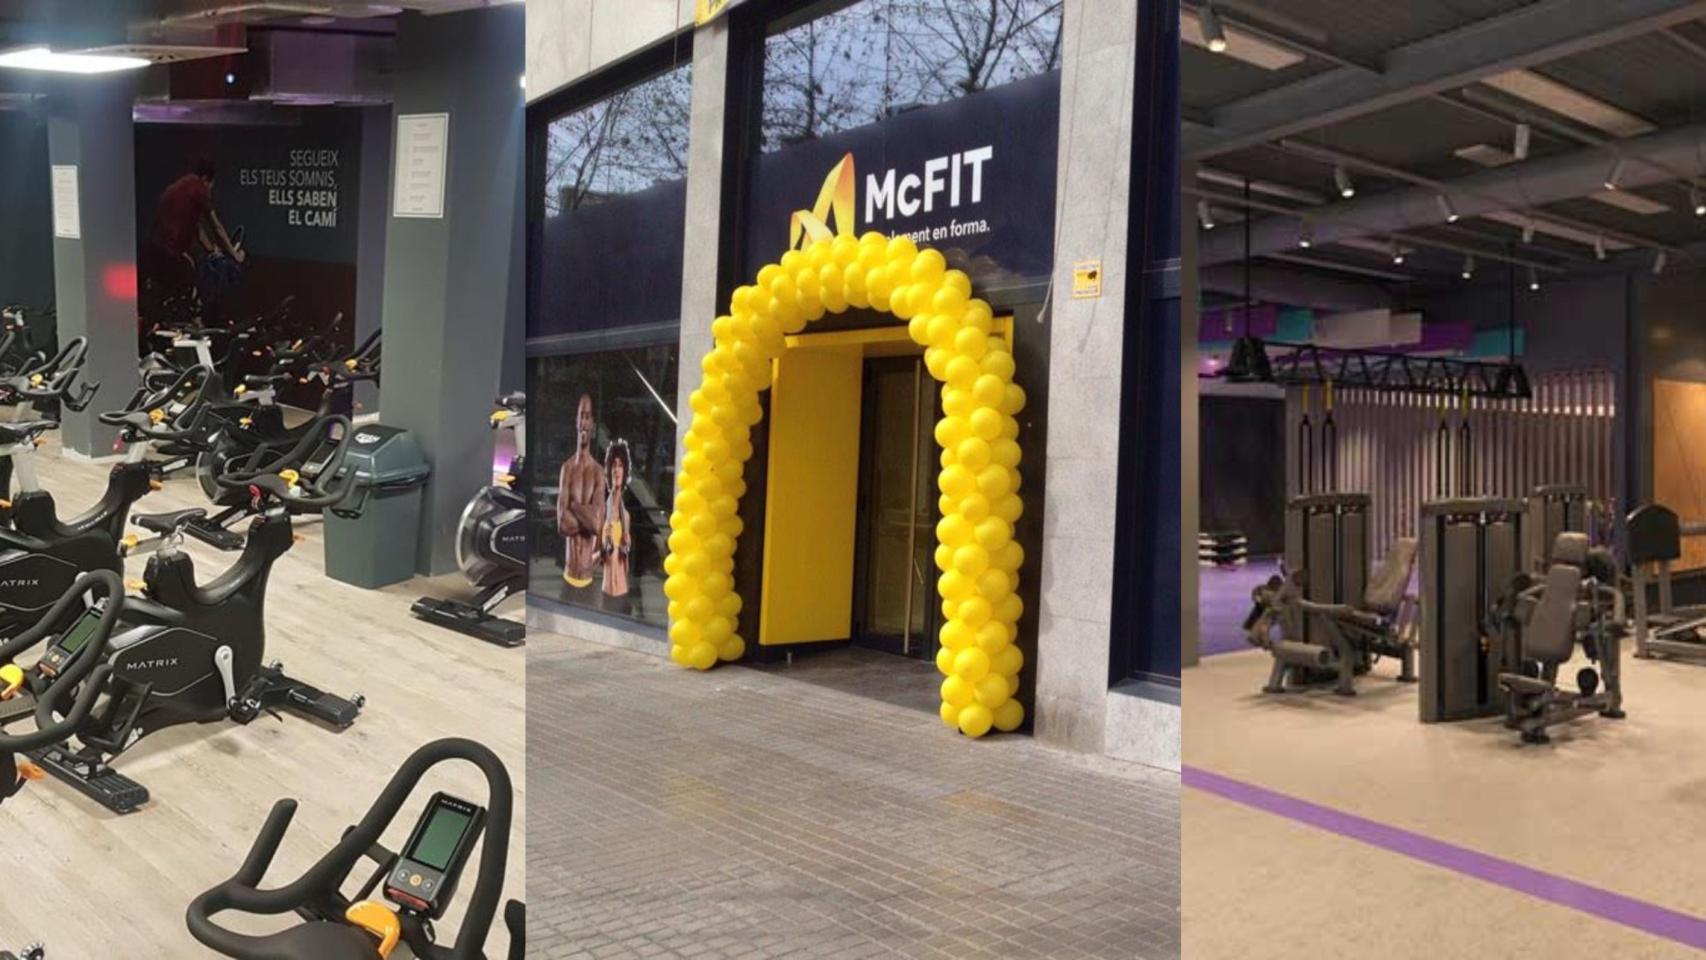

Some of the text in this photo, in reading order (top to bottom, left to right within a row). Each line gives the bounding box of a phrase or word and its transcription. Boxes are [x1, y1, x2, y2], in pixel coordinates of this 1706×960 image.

[290, 149, 339, 167] SEGUEIX
[240, 169, 338, 189] ELS TEUS SOMNIS,
[865, 145, 993, 224] McFIT
[269, 189, 337, 207] ELLS SABEN
[288, 207, 338, 228] EL CAMÍ
[932, 226, 948, 240] en
[950, 219, 990, 238] forma.
[126, 657, 178, 670] MATRIX
